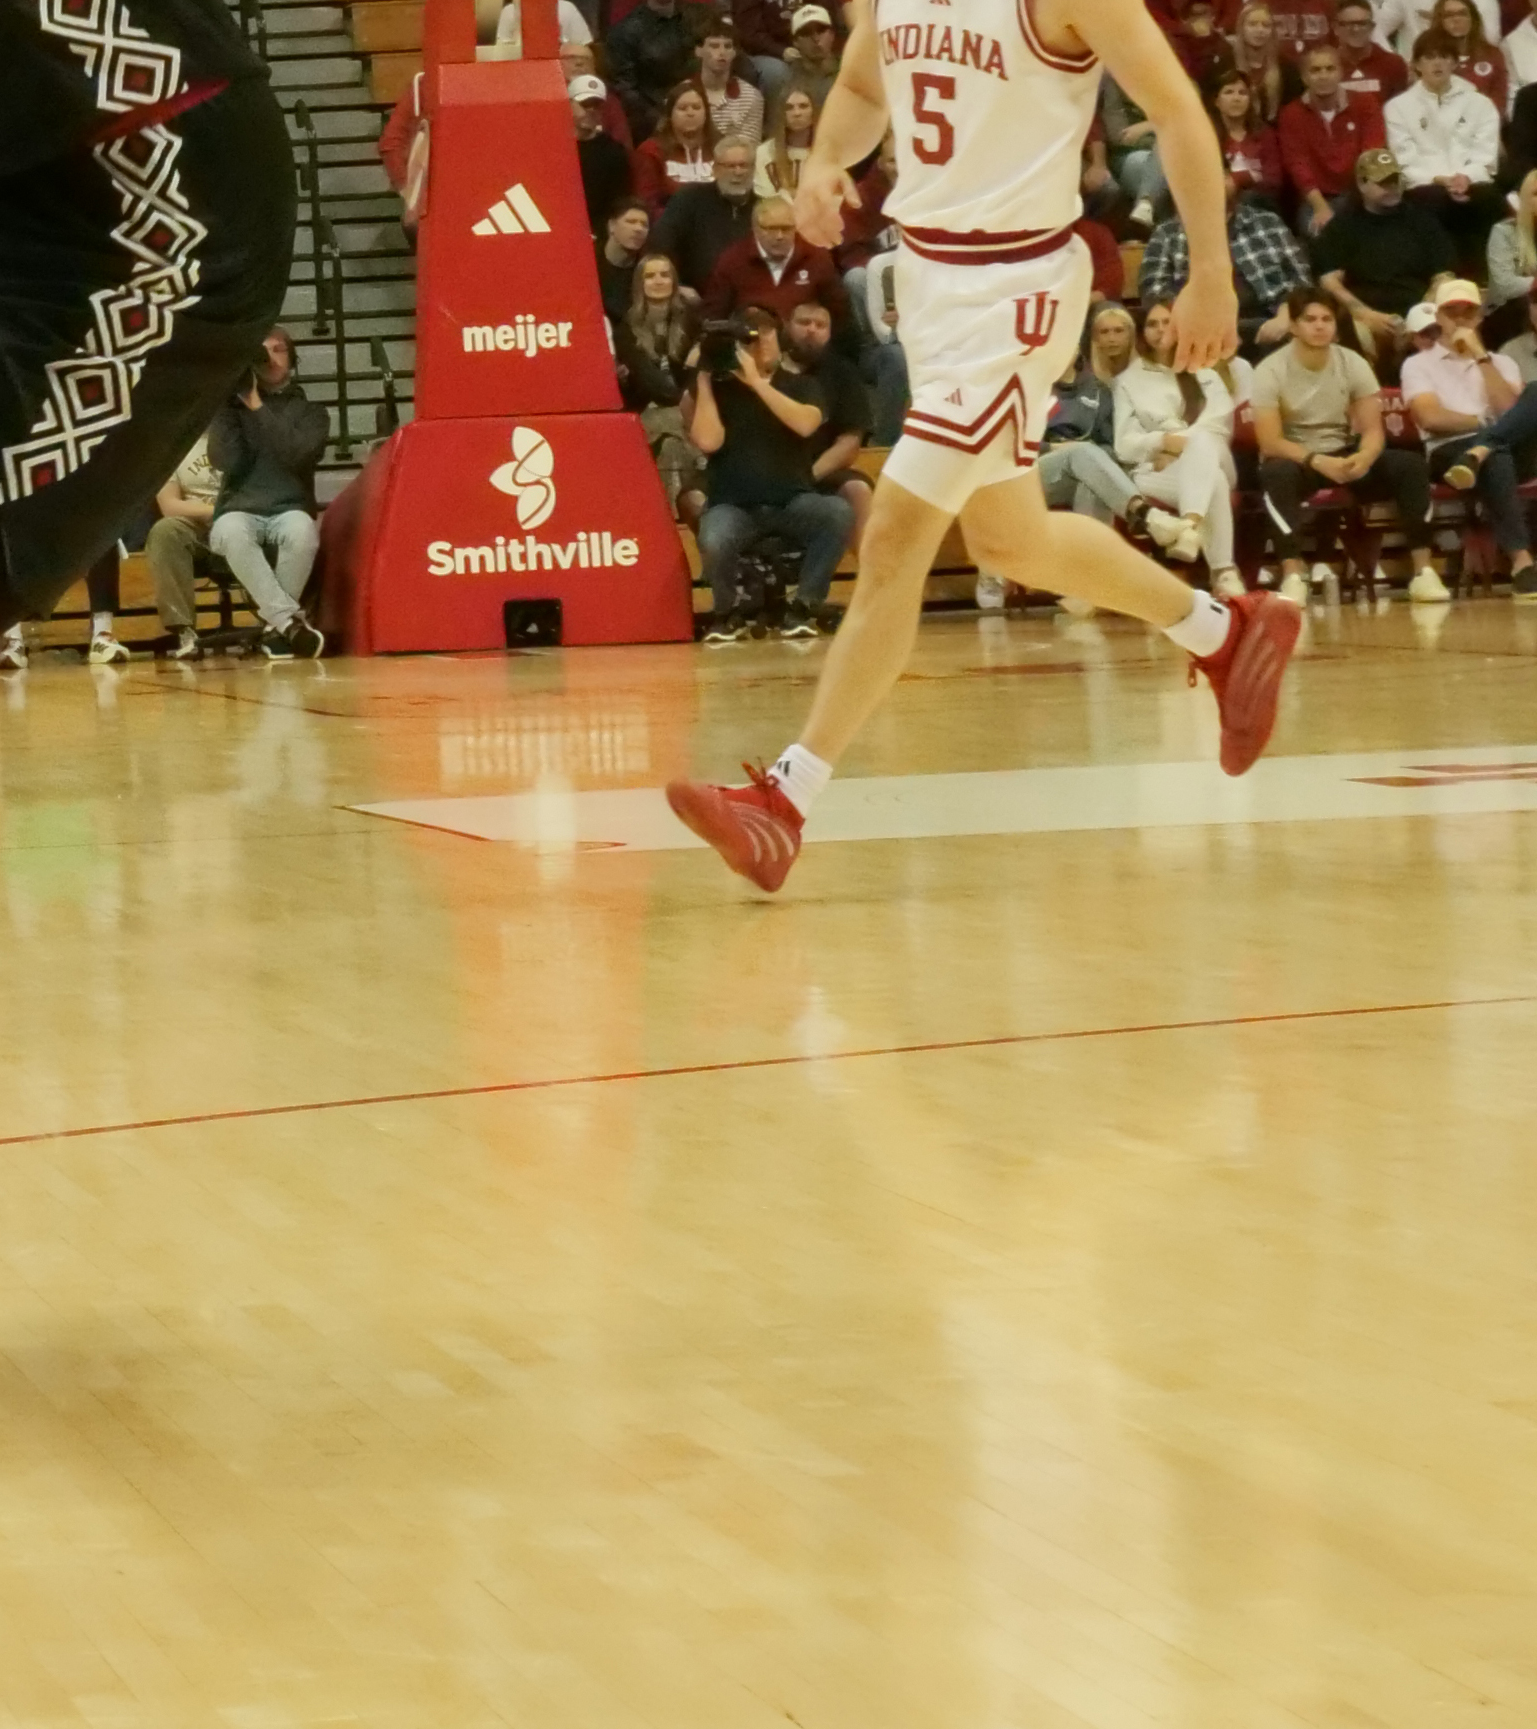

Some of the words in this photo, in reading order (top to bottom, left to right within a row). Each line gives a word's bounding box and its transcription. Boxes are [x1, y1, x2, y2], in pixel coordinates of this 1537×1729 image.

[879, 22, 1009, 81] INDIANA
[911, 72, 956, 167] 5
[463, 314, 572, 357] meijer
[427, 531, 639, 576] Smithville
